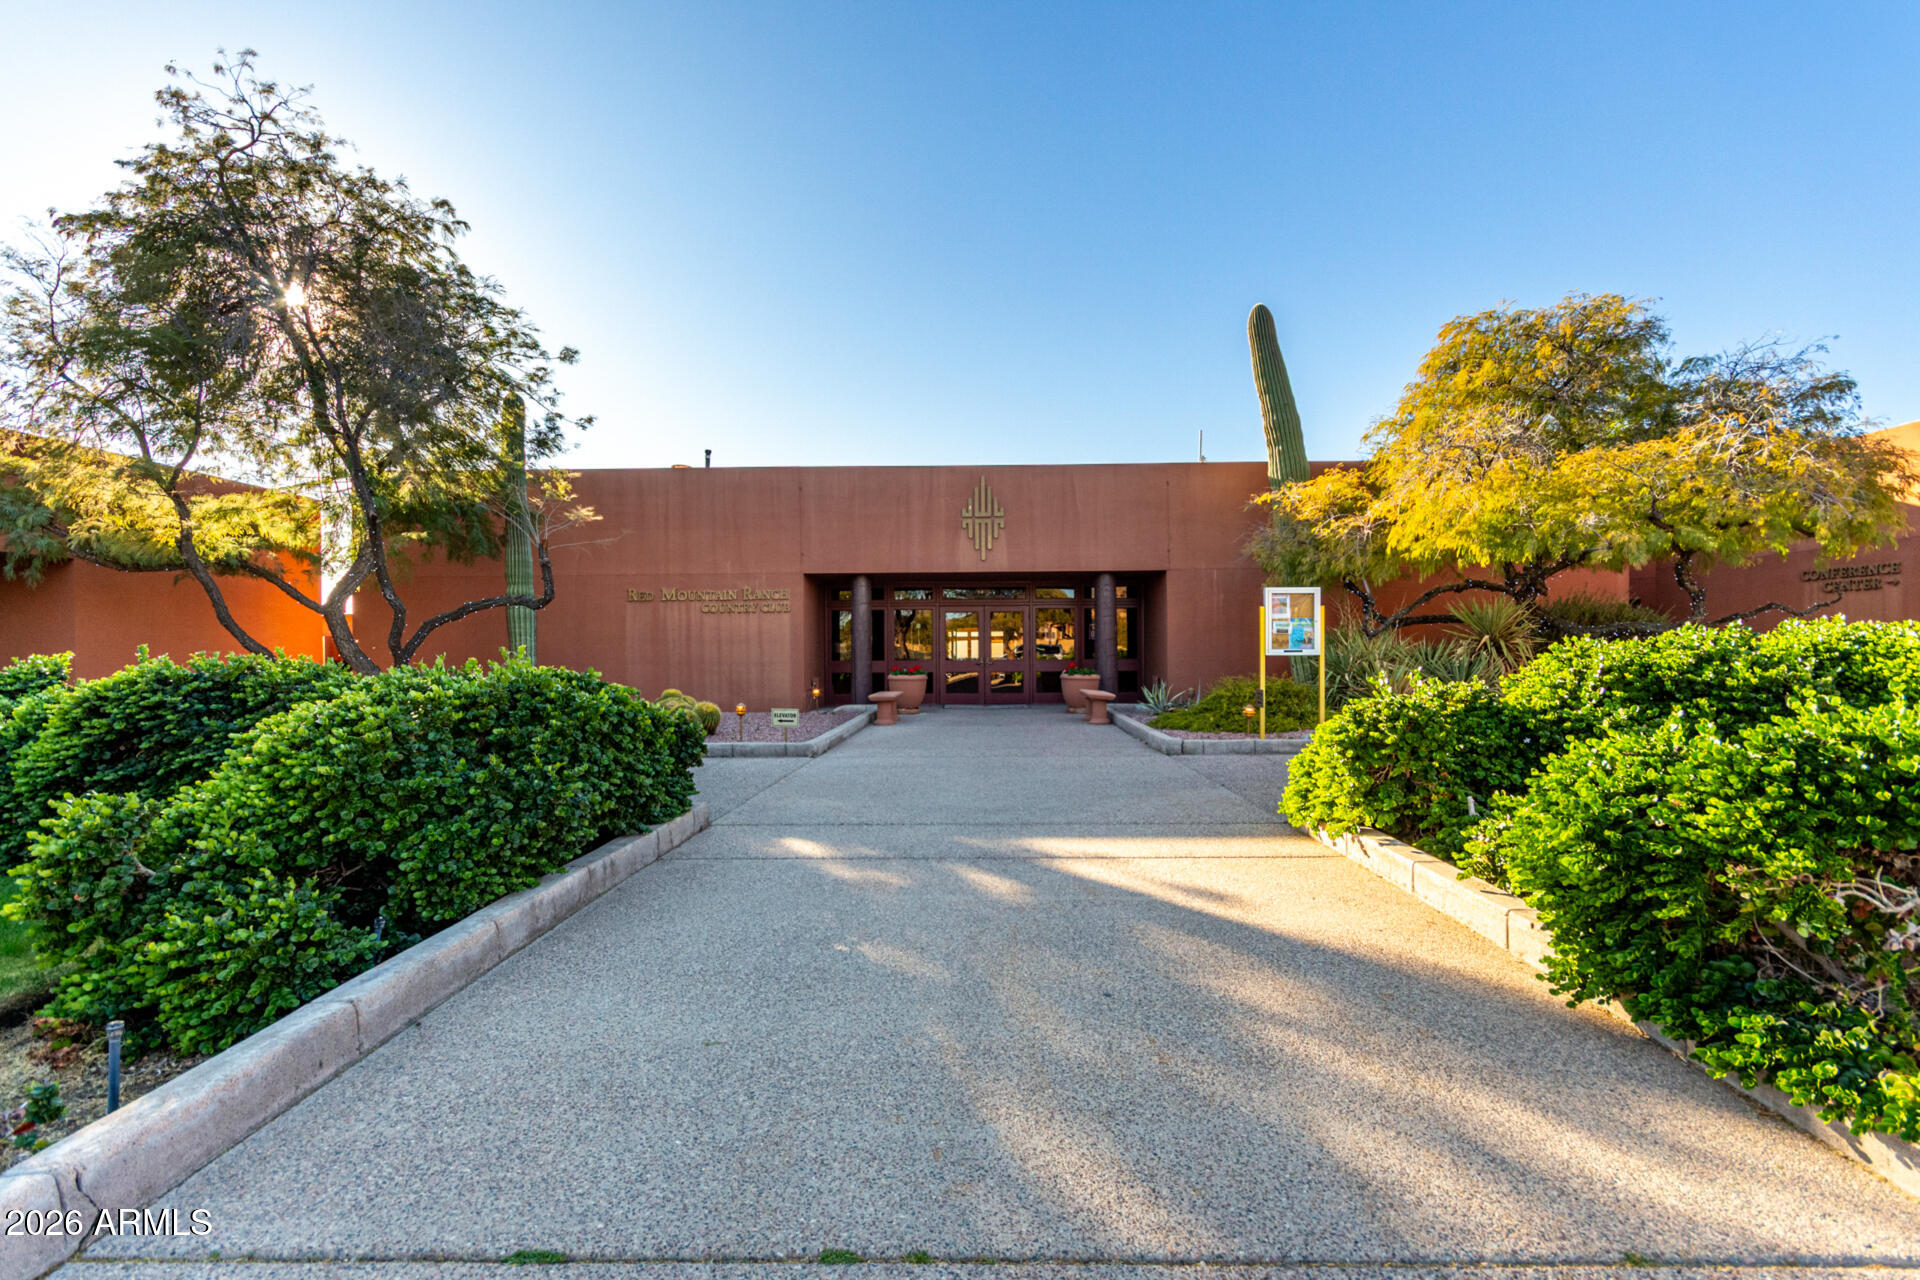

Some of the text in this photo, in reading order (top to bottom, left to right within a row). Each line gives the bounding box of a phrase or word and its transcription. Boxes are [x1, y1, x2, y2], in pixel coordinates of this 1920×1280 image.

[1801, 562, 1901, 582] CONFERENCE
[1823, 578, 1883, 593] CENTER
[660, 587, 737, 601] MOUNTAIN
[742, 586, 789, 600] RANCH
[701, 602, 791, 613] COUNTRY CLUB
